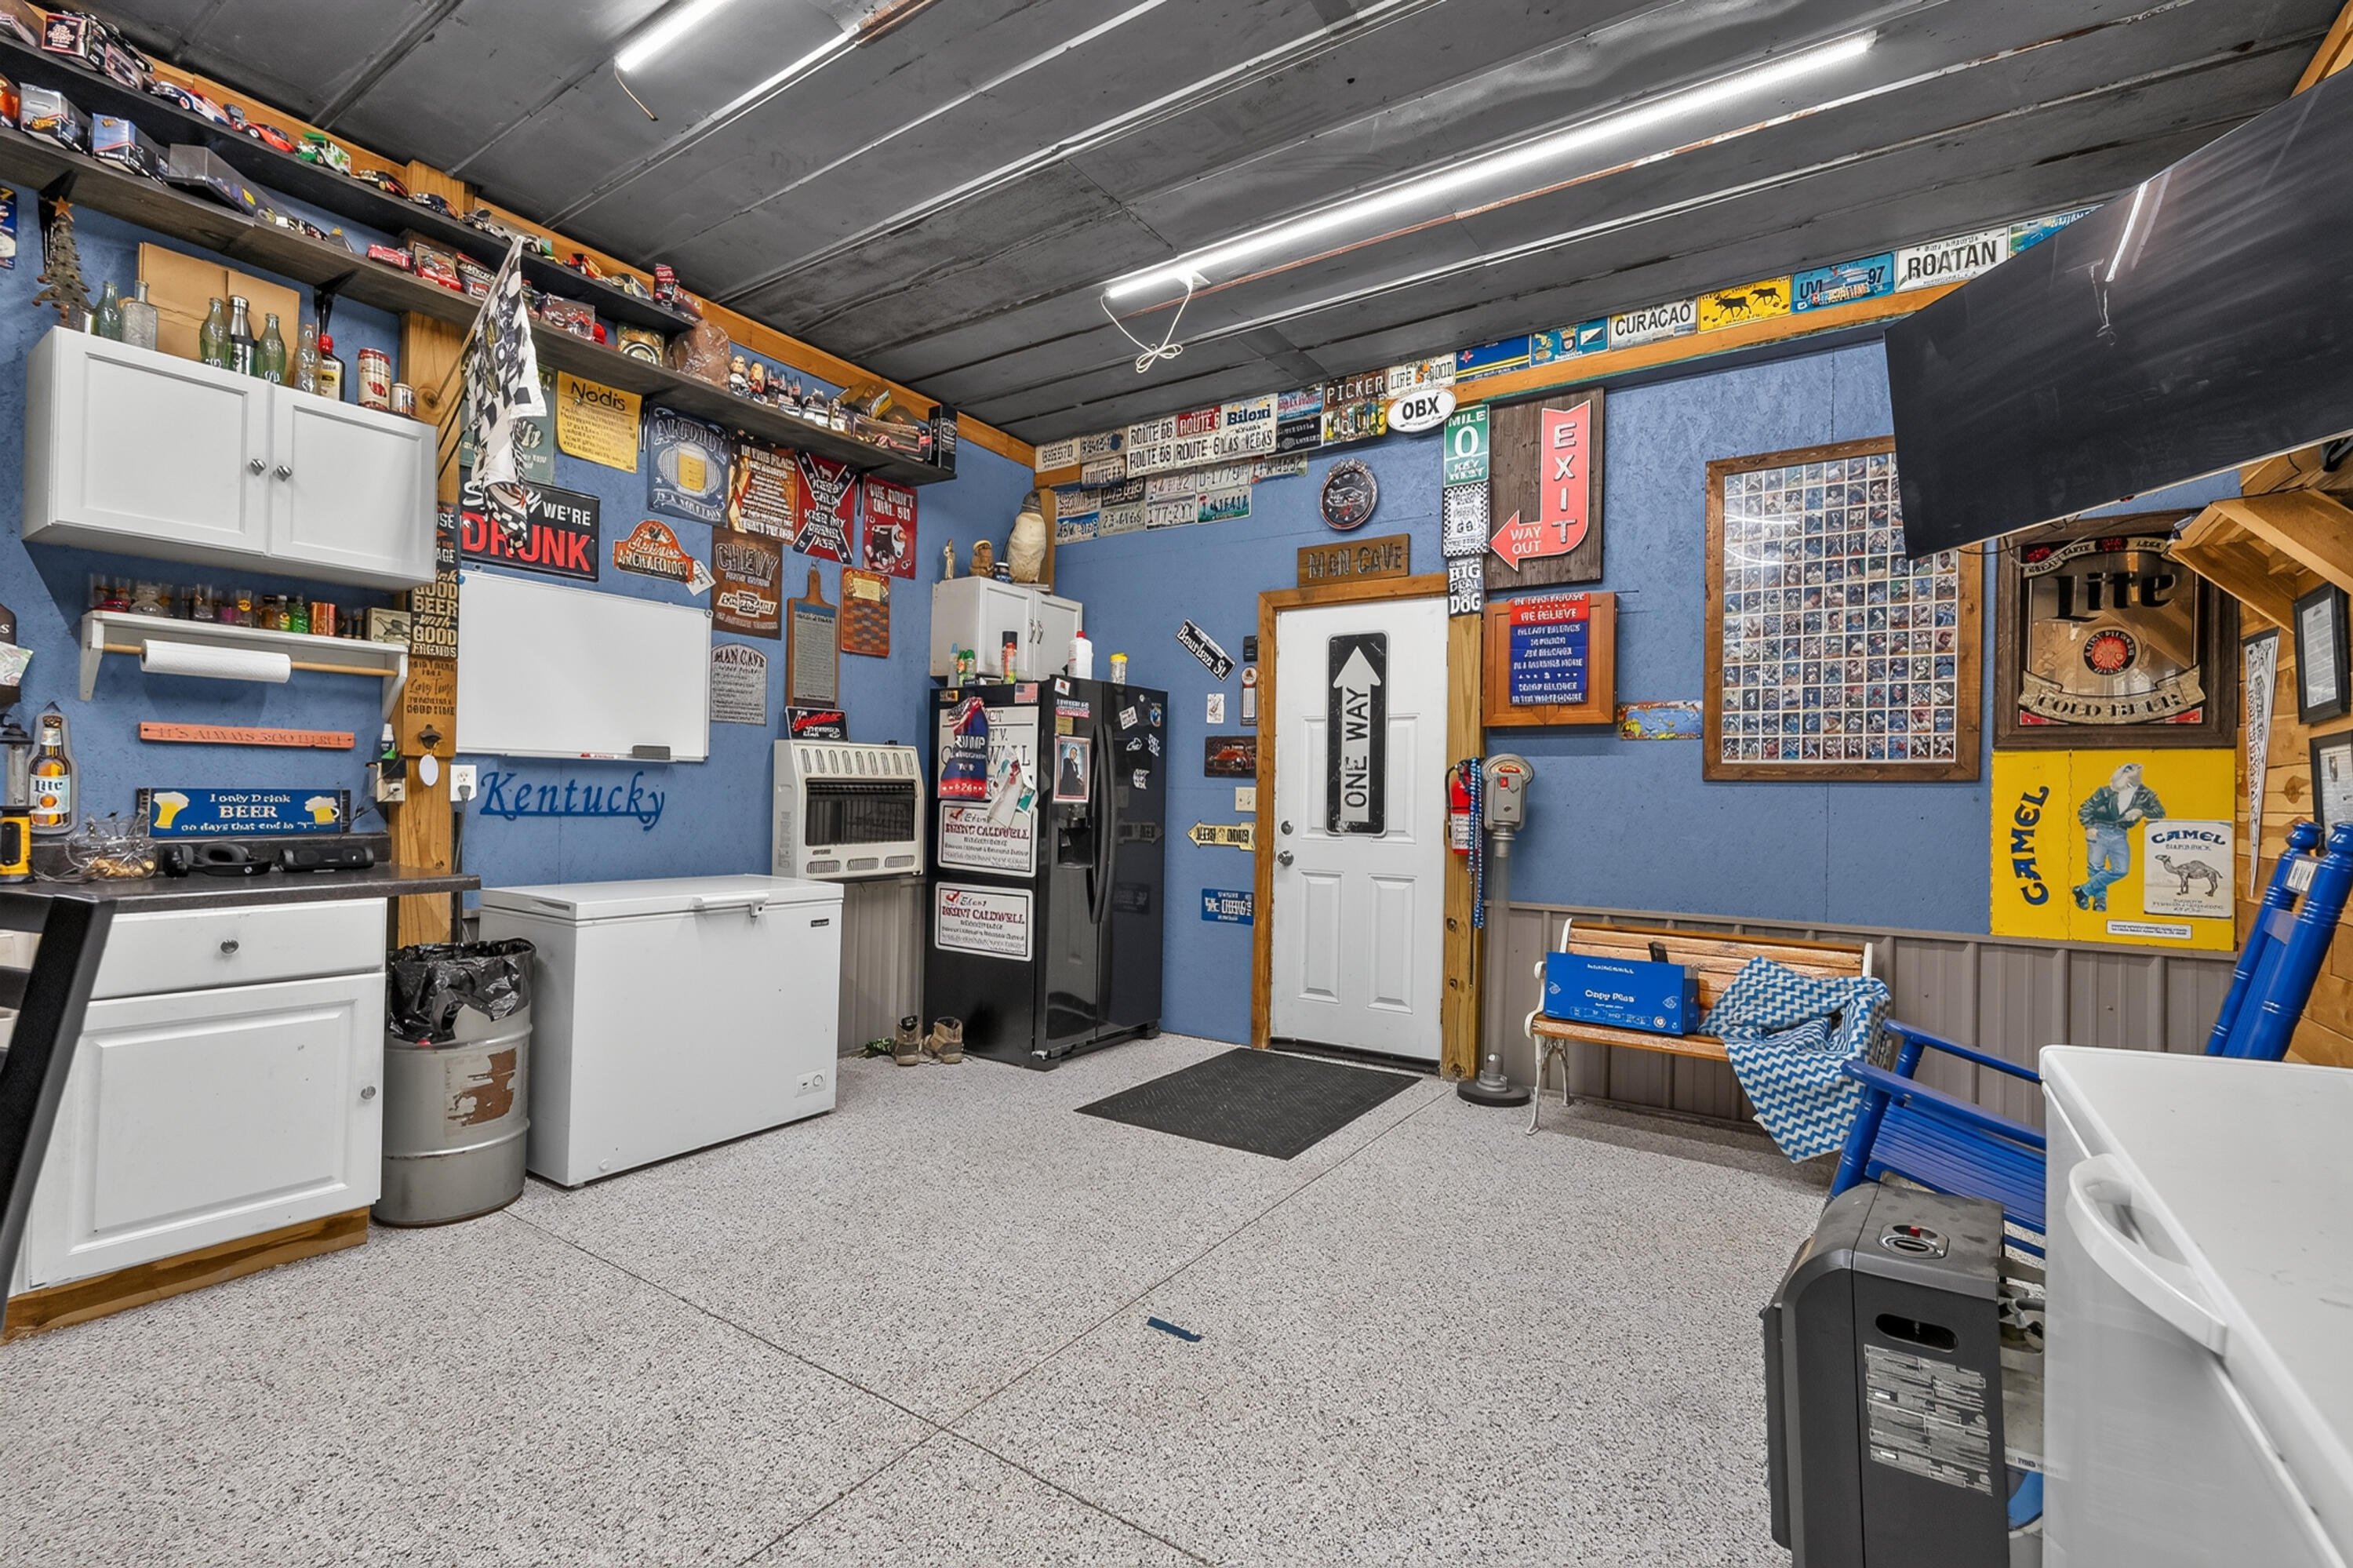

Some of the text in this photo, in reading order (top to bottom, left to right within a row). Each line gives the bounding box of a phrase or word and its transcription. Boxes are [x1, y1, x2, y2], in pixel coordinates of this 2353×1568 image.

[1907, 240, 1997, 280] ROATAN
[1868, 265, 1886, 285] 97
[1327, 375, 1384, 405] PICKER
[1391, 370, 1412, 390] LIFE
[1402, 395, 1440, 420] OBX
[1449, 409, 1486, 427] MILE
[1131, 424, 1159, 447] ROUTE
[1180, 413, 1213, 435] ROUTE
[1177, 439, 1208, 461] ROUTE
[1454, 425, 1479, 458] 0
[1129, 449, 1158, 471] ROUTE
[1551, 421, 1578, 544] EXIT
[542, 501, 591, 526] WE'RE
[1510, 526, 1542, 541] WAY
[1511, 540, 1542, 555] OUT
[715, 542, 780, 582] CHEVY
[413, 595, 459, 618] BEER
[1451, 591, 1481, 614] DOG
[2046, 572, 2177, 624] Lite
[413, 624, 457, 646] GOOD
[2036, 693, 2102, 716] COLD
[1344, 686, 1369, 809] ONE WAY
[209, 793, 216, 802] I
[479, 770, 665, 831] Kentucky
[219, 805, 278, 819] BEER
[200, 821, 229, 832] days
[231, 822, 256, 831] that
[2151, 829, 2227, 846] CAMEL
[2010, 785, 2050, 906] CAMEL
